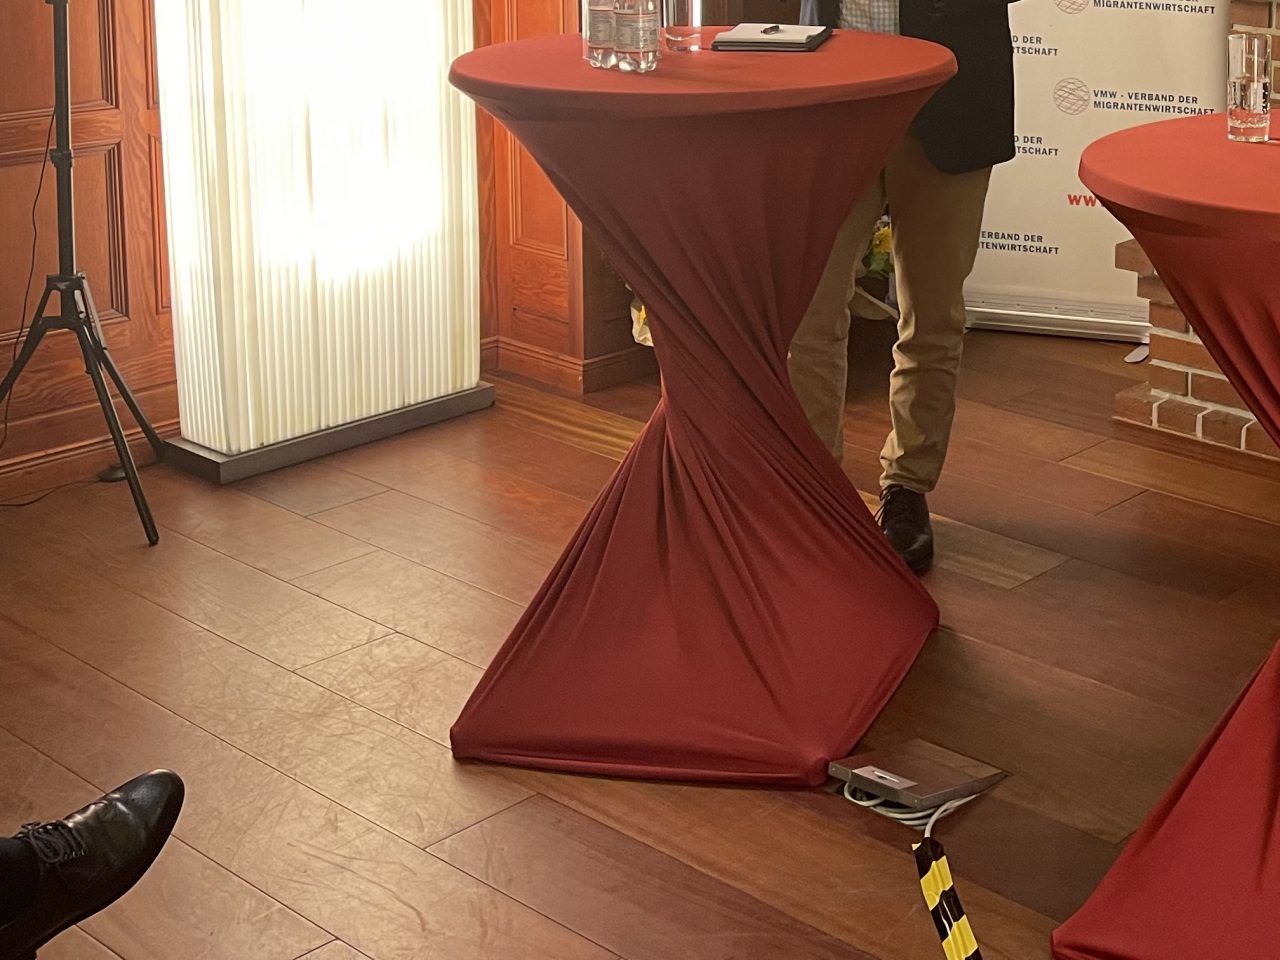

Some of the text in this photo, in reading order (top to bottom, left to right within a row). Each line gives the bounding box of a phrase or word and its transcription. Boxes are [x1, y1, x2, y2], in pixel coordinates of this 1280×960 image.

[1093, 0, 1216, 14] MIGRANTENWIRTSCHAFT
[1022, 35, 1042, 45] DER
[1093, 89, 1117, 99] VMW
[1127, 92, 1175, 102] VERBAND
[1178, 95, 1198, 105] DER
[1023, 135, 1043, 145] DER
[980, 230, 1043, 243] ERBAND DER
[980, 241, 1059, 255] TENWIRTSCHAFT
